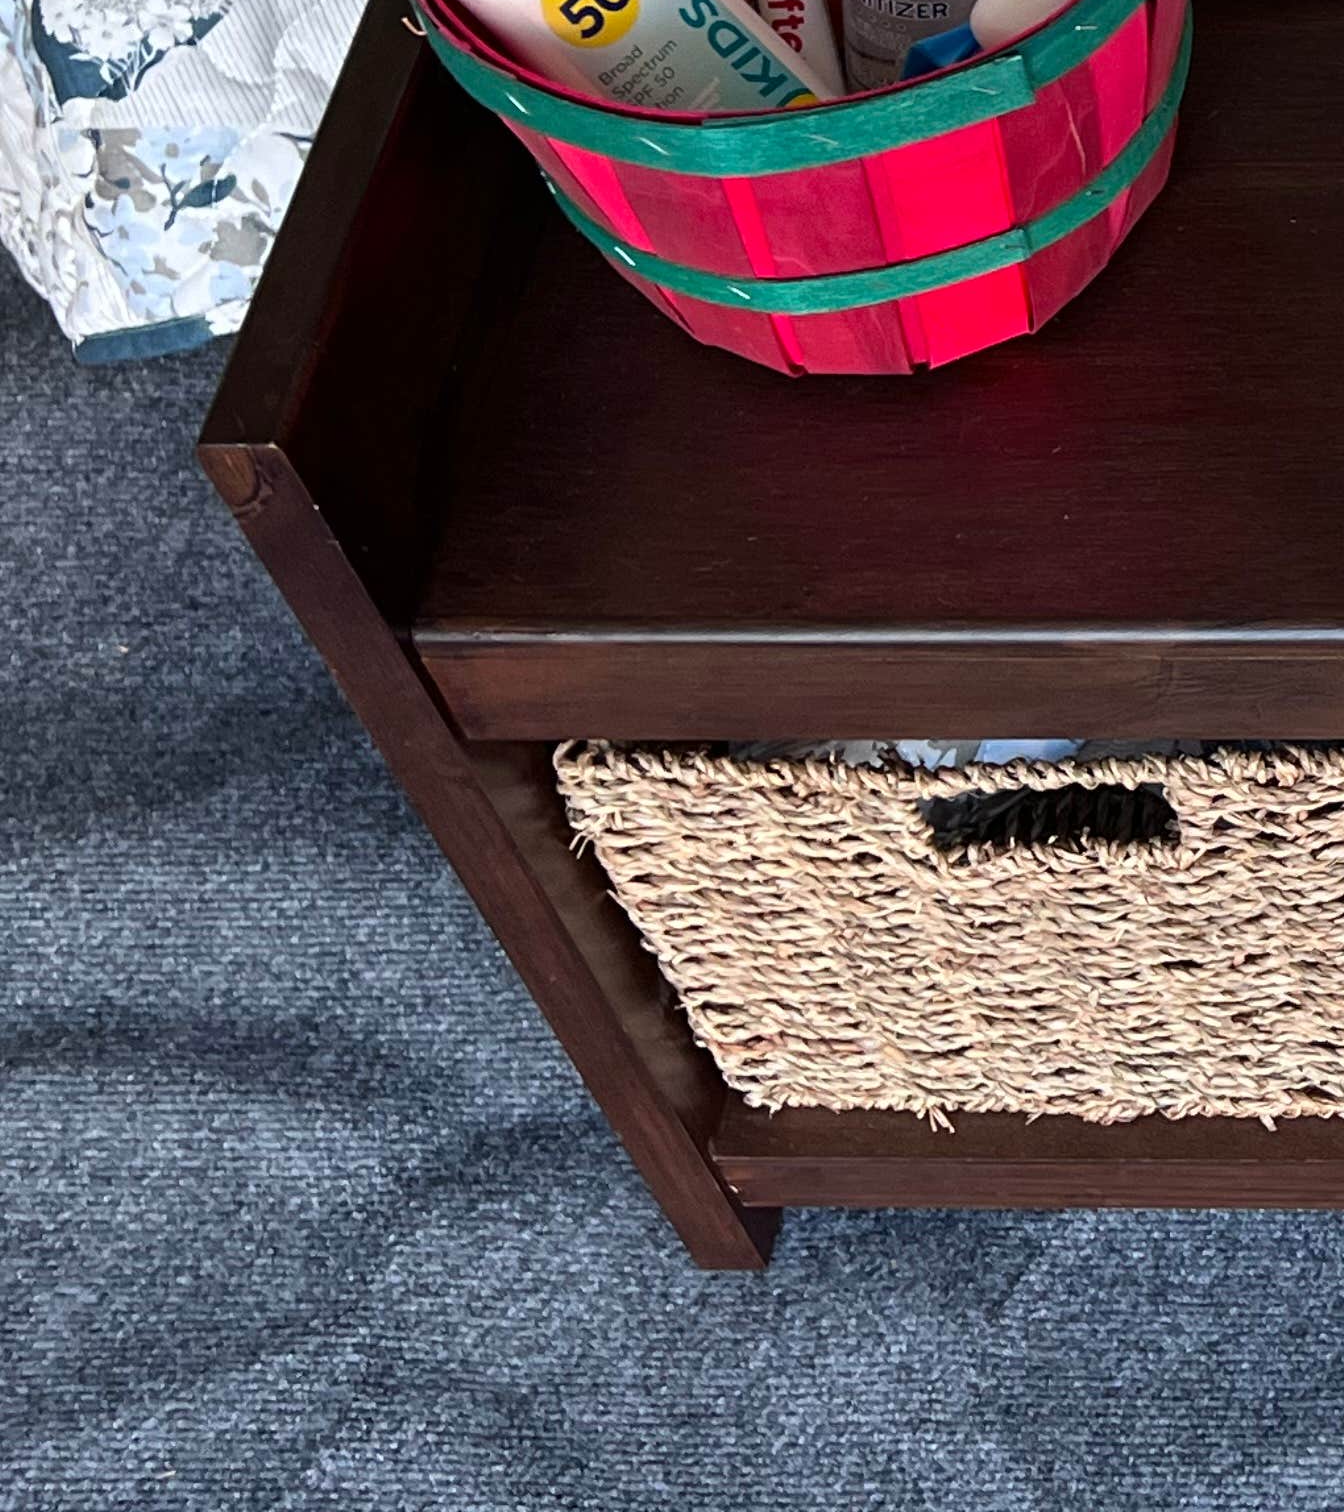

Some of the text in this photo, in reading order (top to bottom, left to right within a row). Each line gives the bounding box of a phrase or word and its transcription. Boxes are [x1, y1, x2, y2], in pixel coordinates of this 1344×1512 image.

[598, 44, 643, 86] Broad
[611, 39, 679, 100] Spectrum
[655, 65, 676, 86] 50
